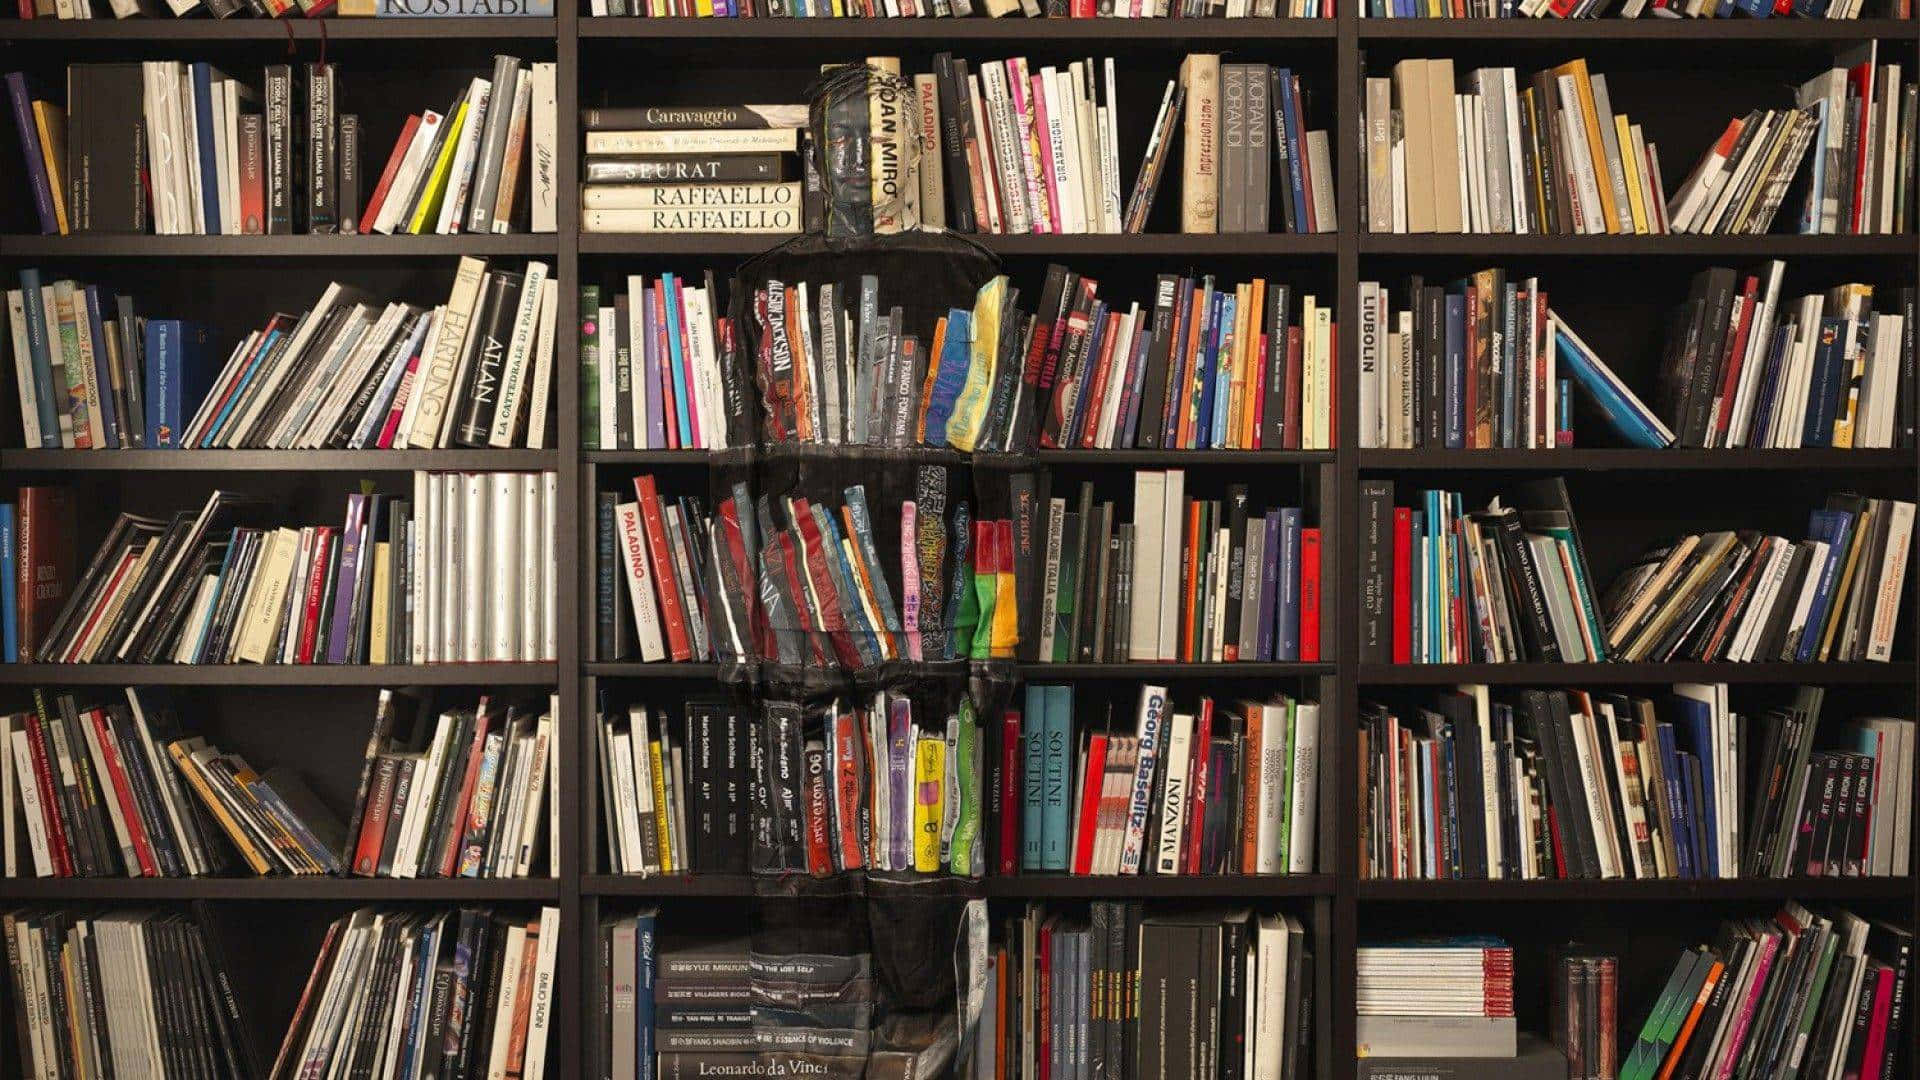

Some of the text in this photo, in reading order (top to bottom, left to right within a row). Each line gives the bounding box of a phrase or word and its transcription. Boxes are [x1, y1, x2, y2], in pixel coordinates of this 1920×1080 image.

[645, 107, 738, 128] Caravaggio
[922, 82, 937, 151] PALADINO
[1226, 70, 1243, 148] MORANDI
[1247, 70, 1266, 148] MORANDI
[625, 161, 722, 180] SEURAT
[653, 186, 792, 206] RAFFAELLO
[653, 209, 792, 229] RAFFAELLO
[1157, 279, 1175, 308] ORLAN
[423, 310, 468, 417] HARTUNG
[501, 346, 526, 420] CATTEDRALE
[523, 271, 540, 327] PALERMO
[768, 311, 792, 371] JACKSON
[1362, 295, 1377, 374] LIUBOLIN
[474, 335, 504, 403] ATLAN
[1401, 331, 1412, 417] ANTONIO BUENO
[623, 510, 646, 580] PALADINO
[1515, 541, 1531, 565] TONO
[1046, 561, 1059, 595] ITALIA
[702, 716, 710, 737] Mario
[702, 737, 711, 768] Schifano
[728, 716, 736, 737] Mario
[728, 737, 737, 768] Schifano
[1027, 730, 1042, 808] SOUTINE
[1047, 729, 1063, 808] SOUTINE
[1131, 694, 1163, 829] Georg Baselitz
[1162, 778, 1183, 853] MANZONI
[699, 1059, 829, 1077] Leonardo da Vinci
